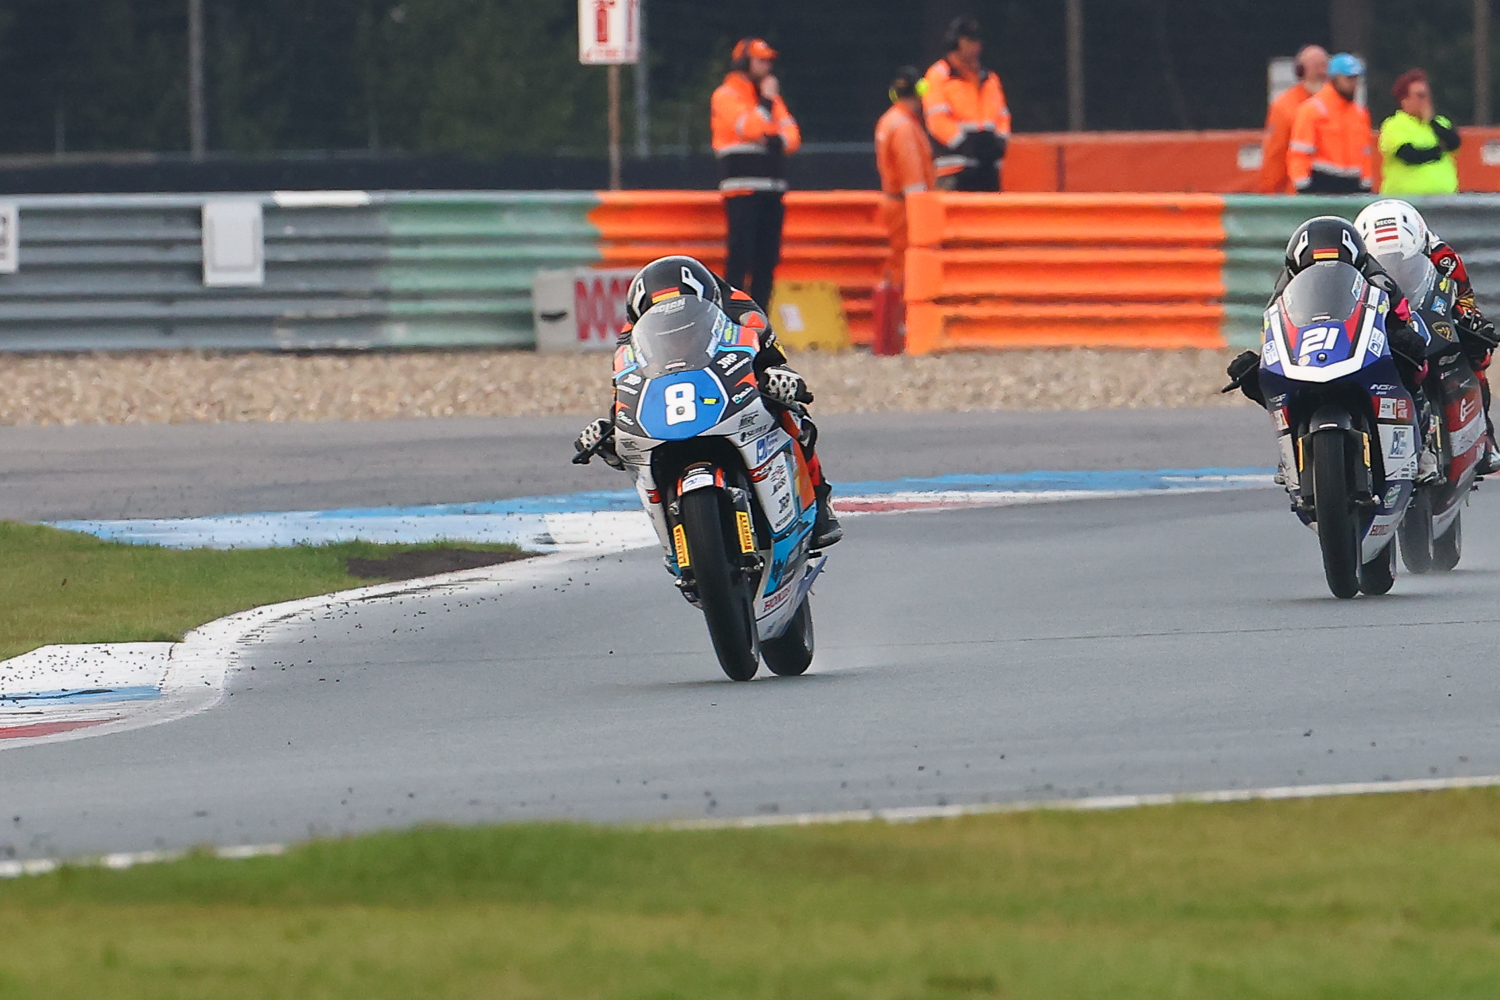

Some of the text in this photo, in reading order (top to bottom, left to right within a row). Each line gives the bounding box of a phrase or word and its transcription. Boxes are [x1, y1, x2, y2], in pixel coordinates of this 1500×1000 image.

[574, 277, 633, 341] DOC
[1299, 326, 1340, 357] 21
[716, 352, 738, 369] JRP
[664, 382, 697, 426] 8
